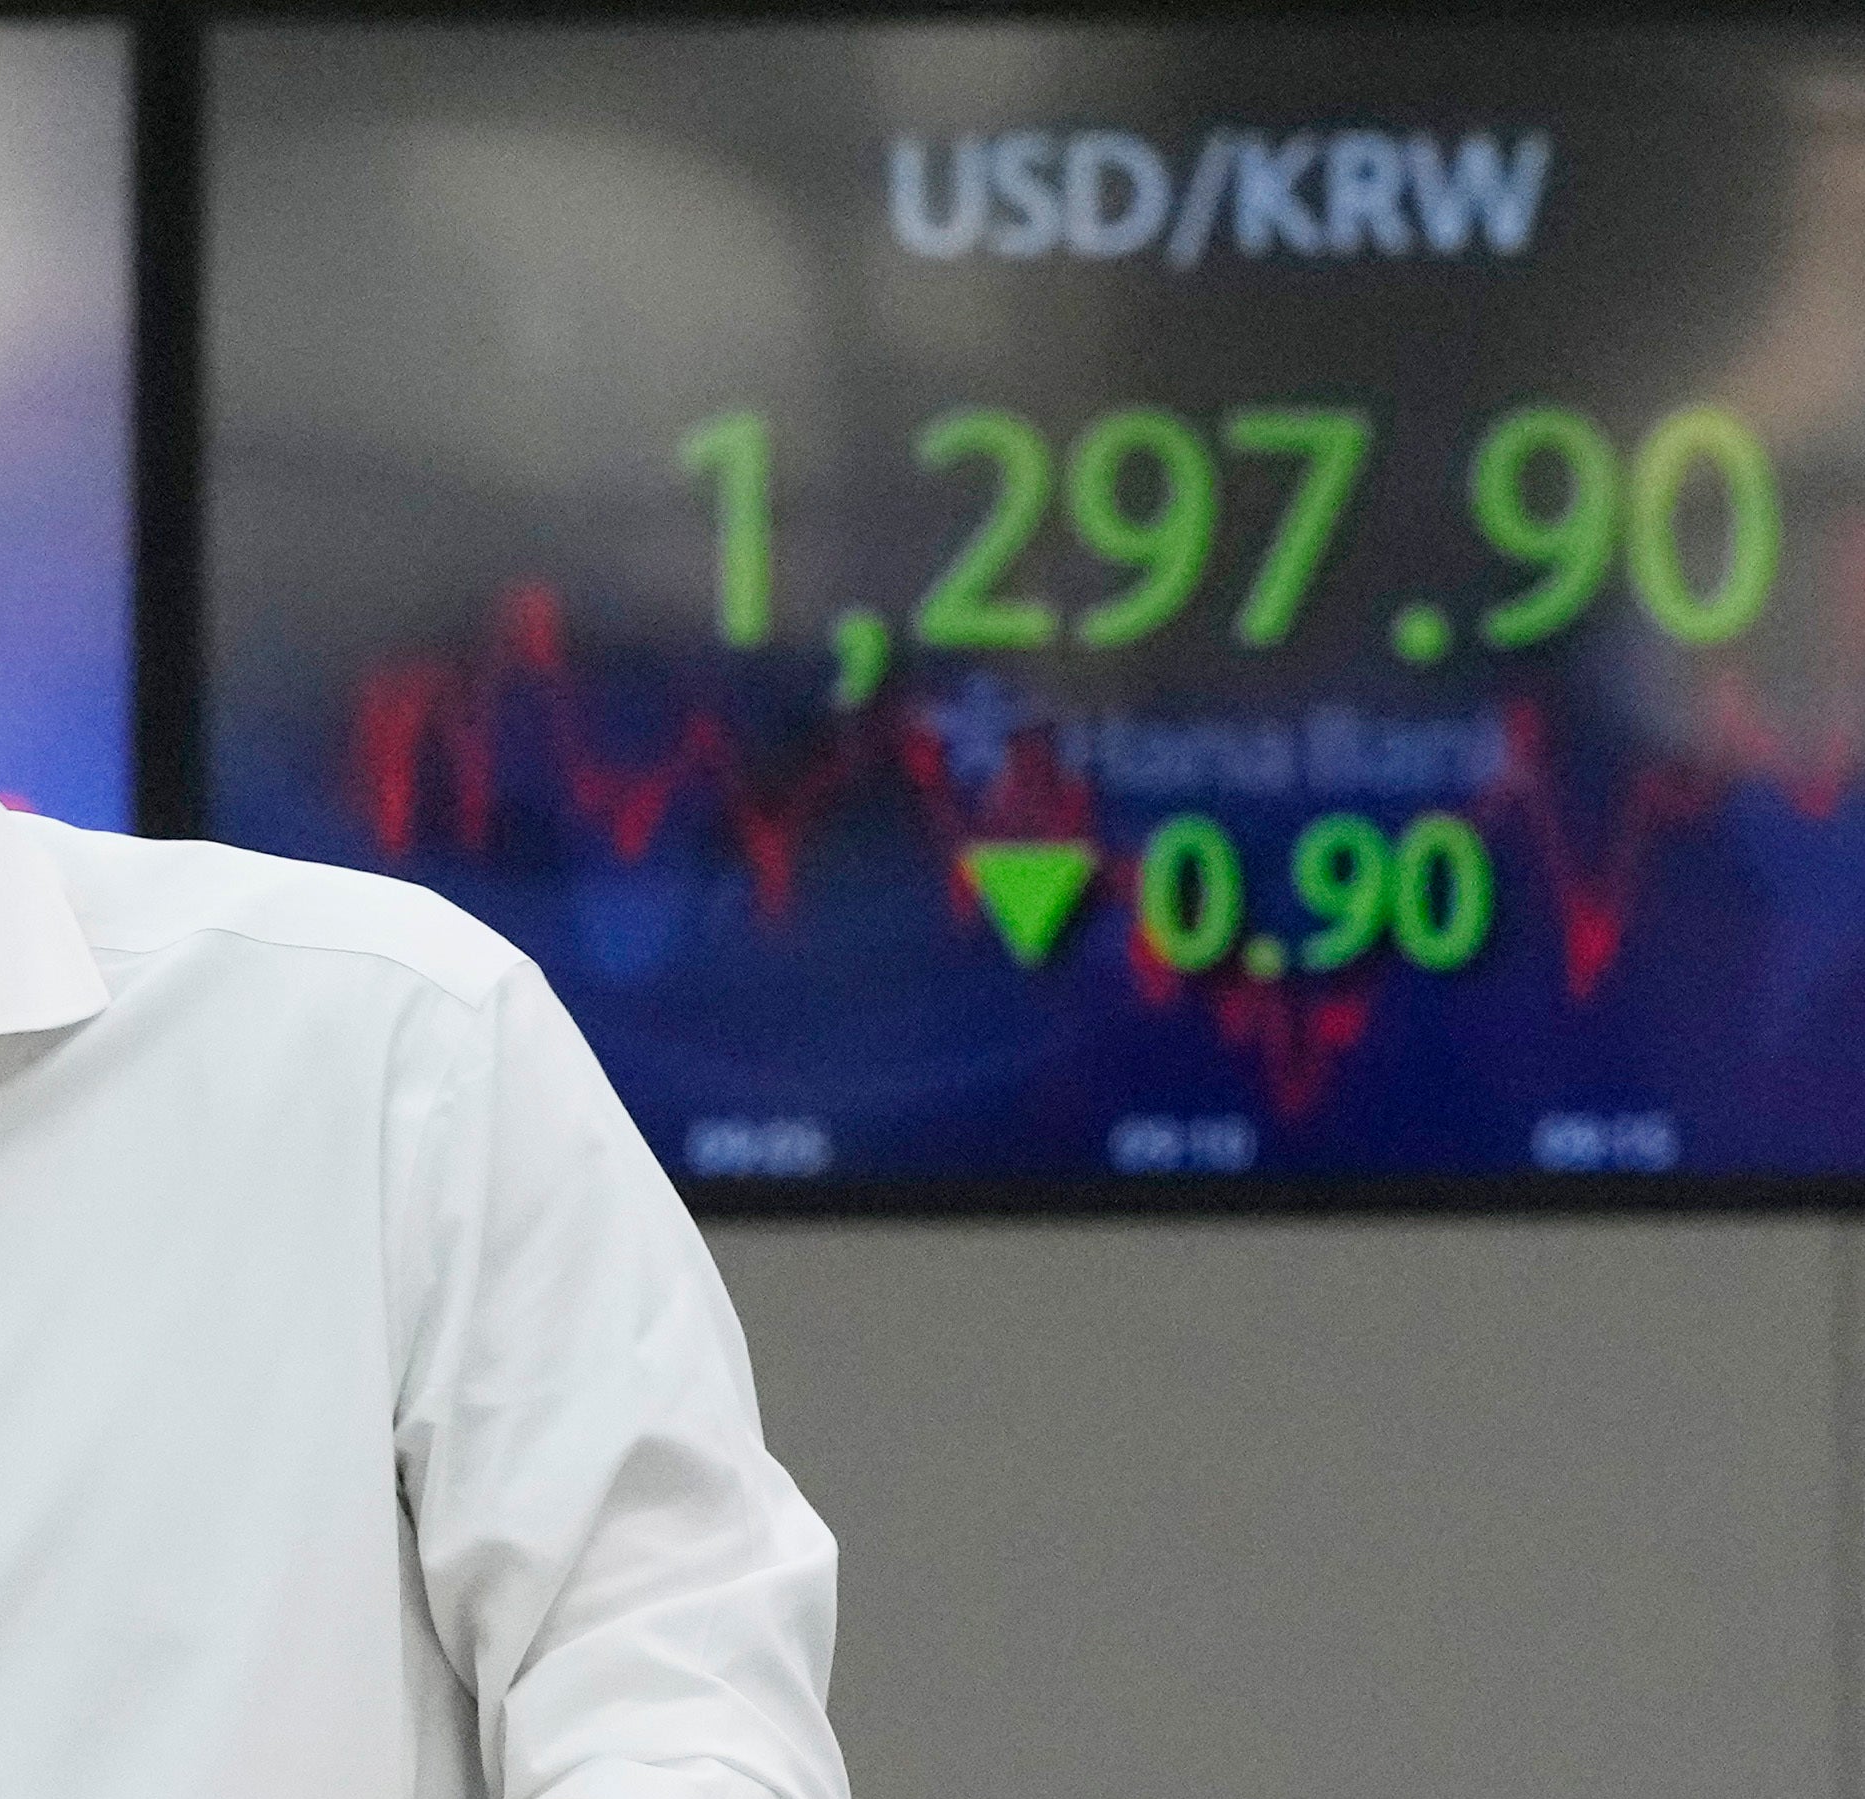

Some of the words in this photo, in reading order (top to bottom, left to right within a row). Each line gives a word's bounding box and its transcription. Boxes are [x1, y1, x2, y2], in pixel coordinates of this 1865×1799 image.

[887, 130, 1551, 270] USD/KRW
[680, 403, 1781, 708] 1,297.90
[1139, 810, 1495, 982] 0.90
